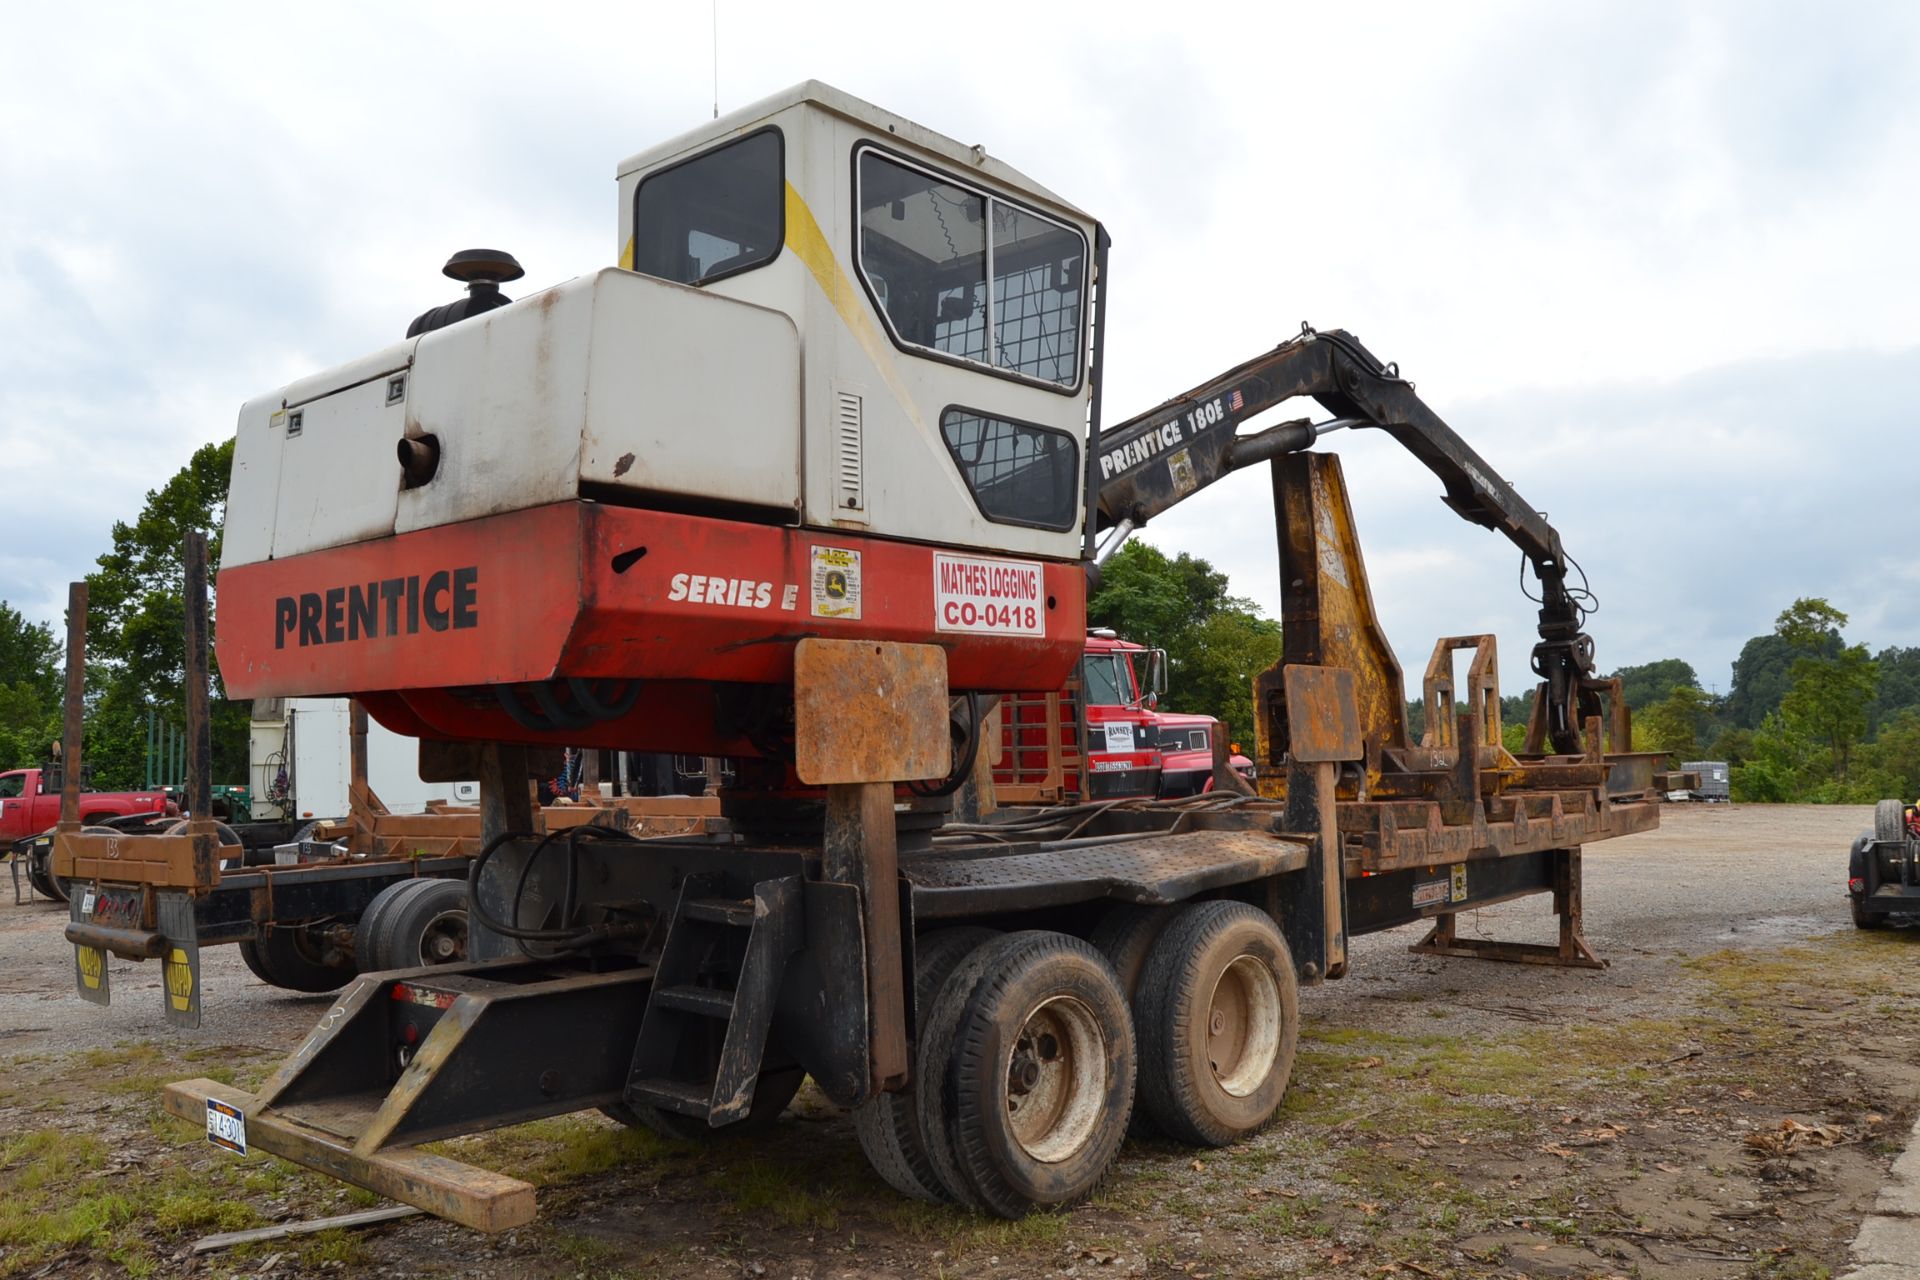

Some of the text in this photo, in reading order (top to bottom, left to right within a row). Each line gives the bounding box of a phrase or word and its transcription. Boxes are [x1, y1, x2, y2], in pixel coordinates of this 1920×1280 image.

[1187, 398, 1225, 434] 180E
[667, 573, 773, 609] SERIES
[782, 584, 799, 610] E
[940, 562, 1037, 600] MATHES LOGGING
[275, 566, 478, 649] PRENTICE
[944, 602, 1037, 629] CO-0418
[167, 963, 193, 998] NAPA
